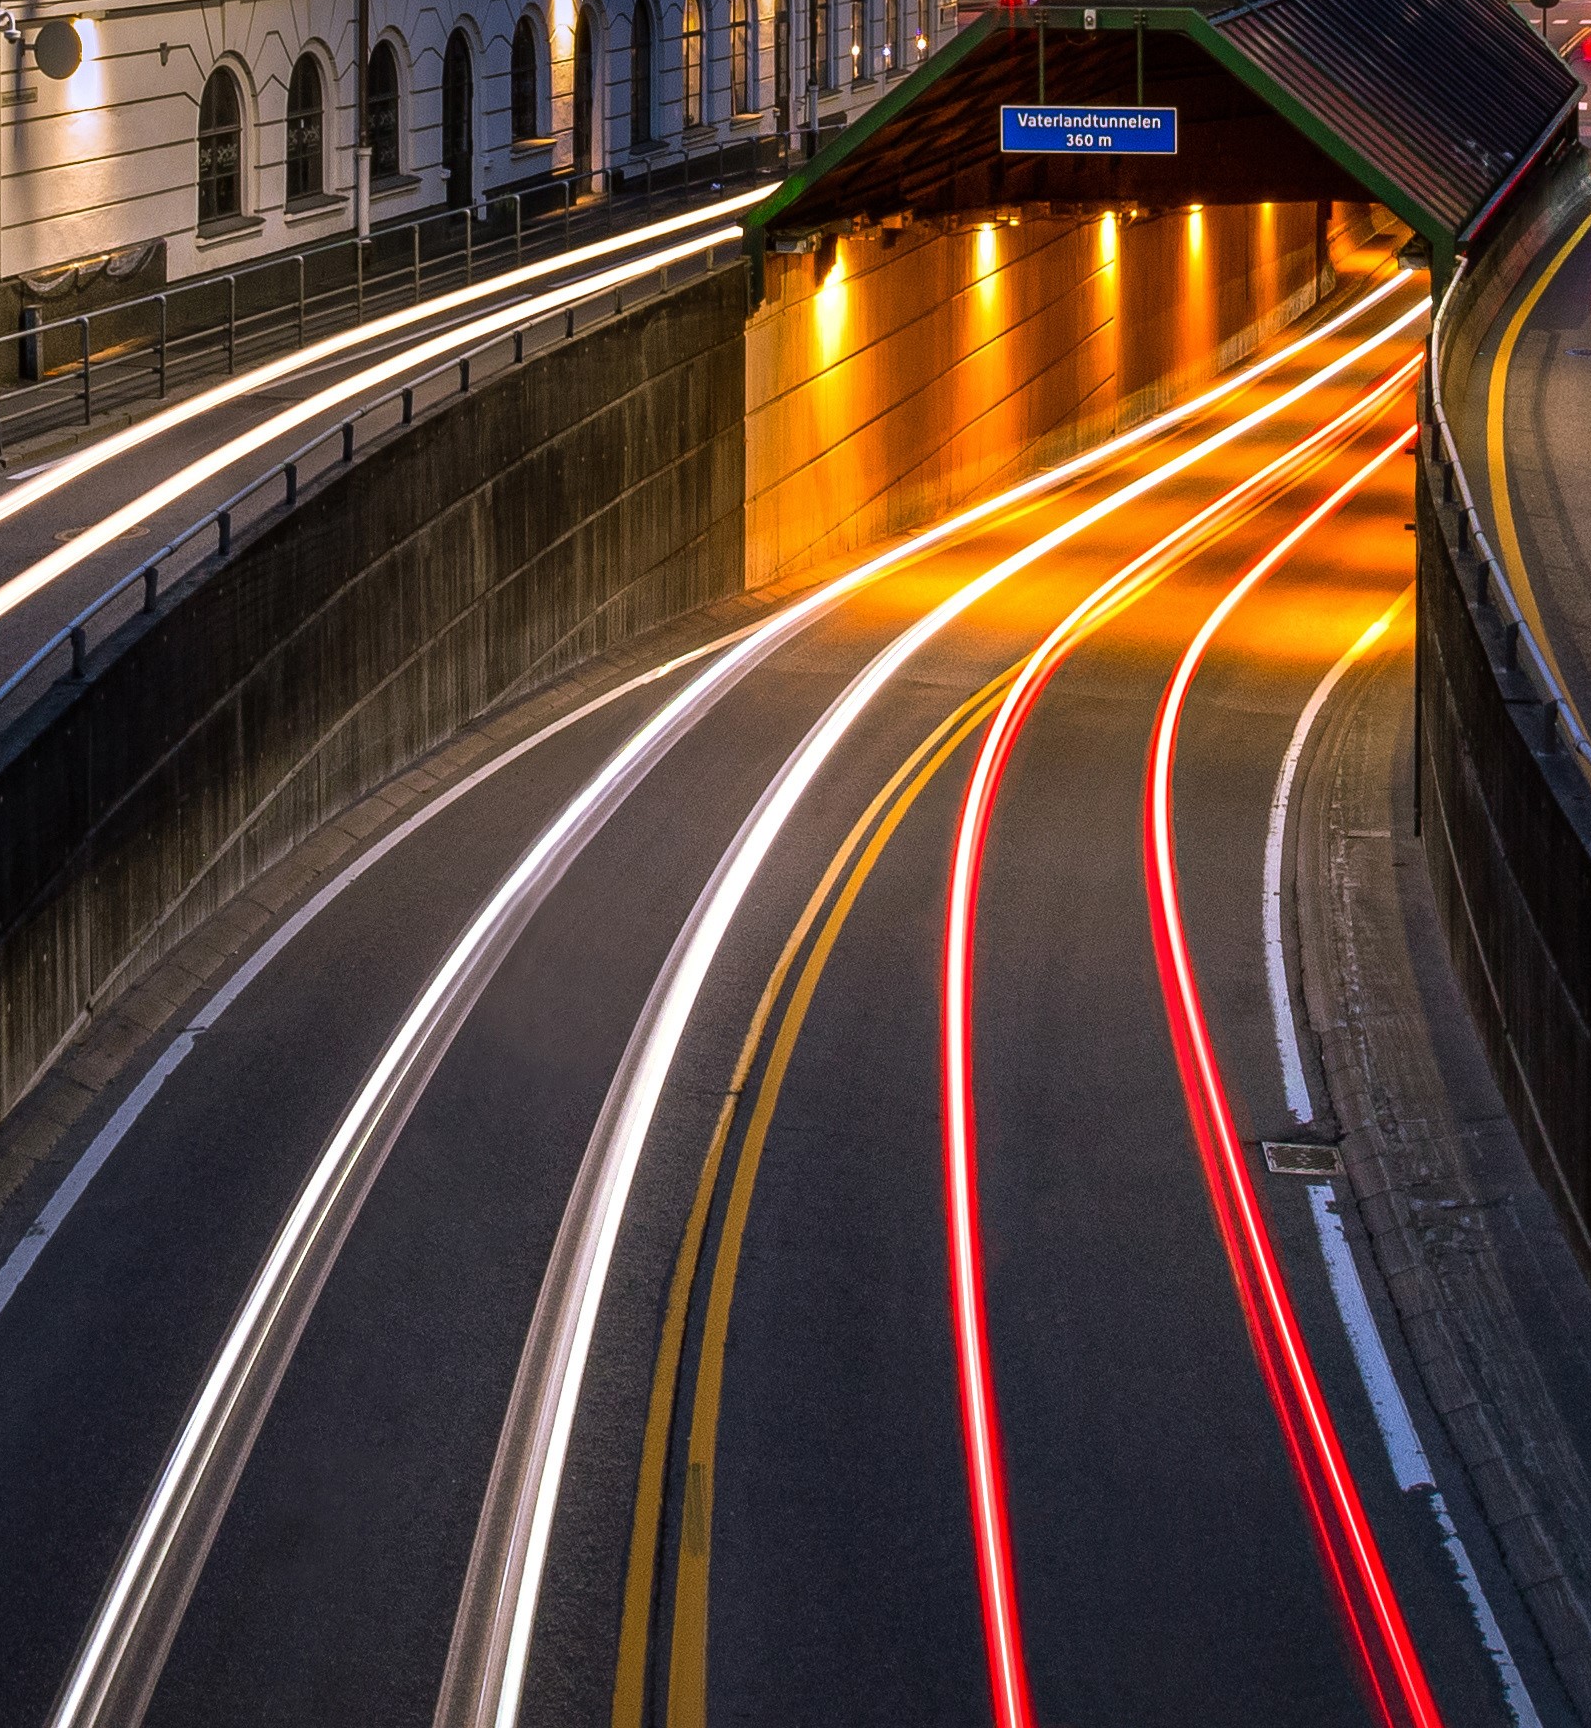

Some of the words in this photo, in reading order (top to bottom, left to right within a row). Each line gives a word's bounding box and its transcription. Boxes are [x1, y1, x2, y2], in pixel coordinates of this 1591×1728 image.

[1017, 112, 1161, 129] Vaterlandtunnelen
[1066, 133, 1094, 147] 360
[1098, 136, 1112, 147] m
